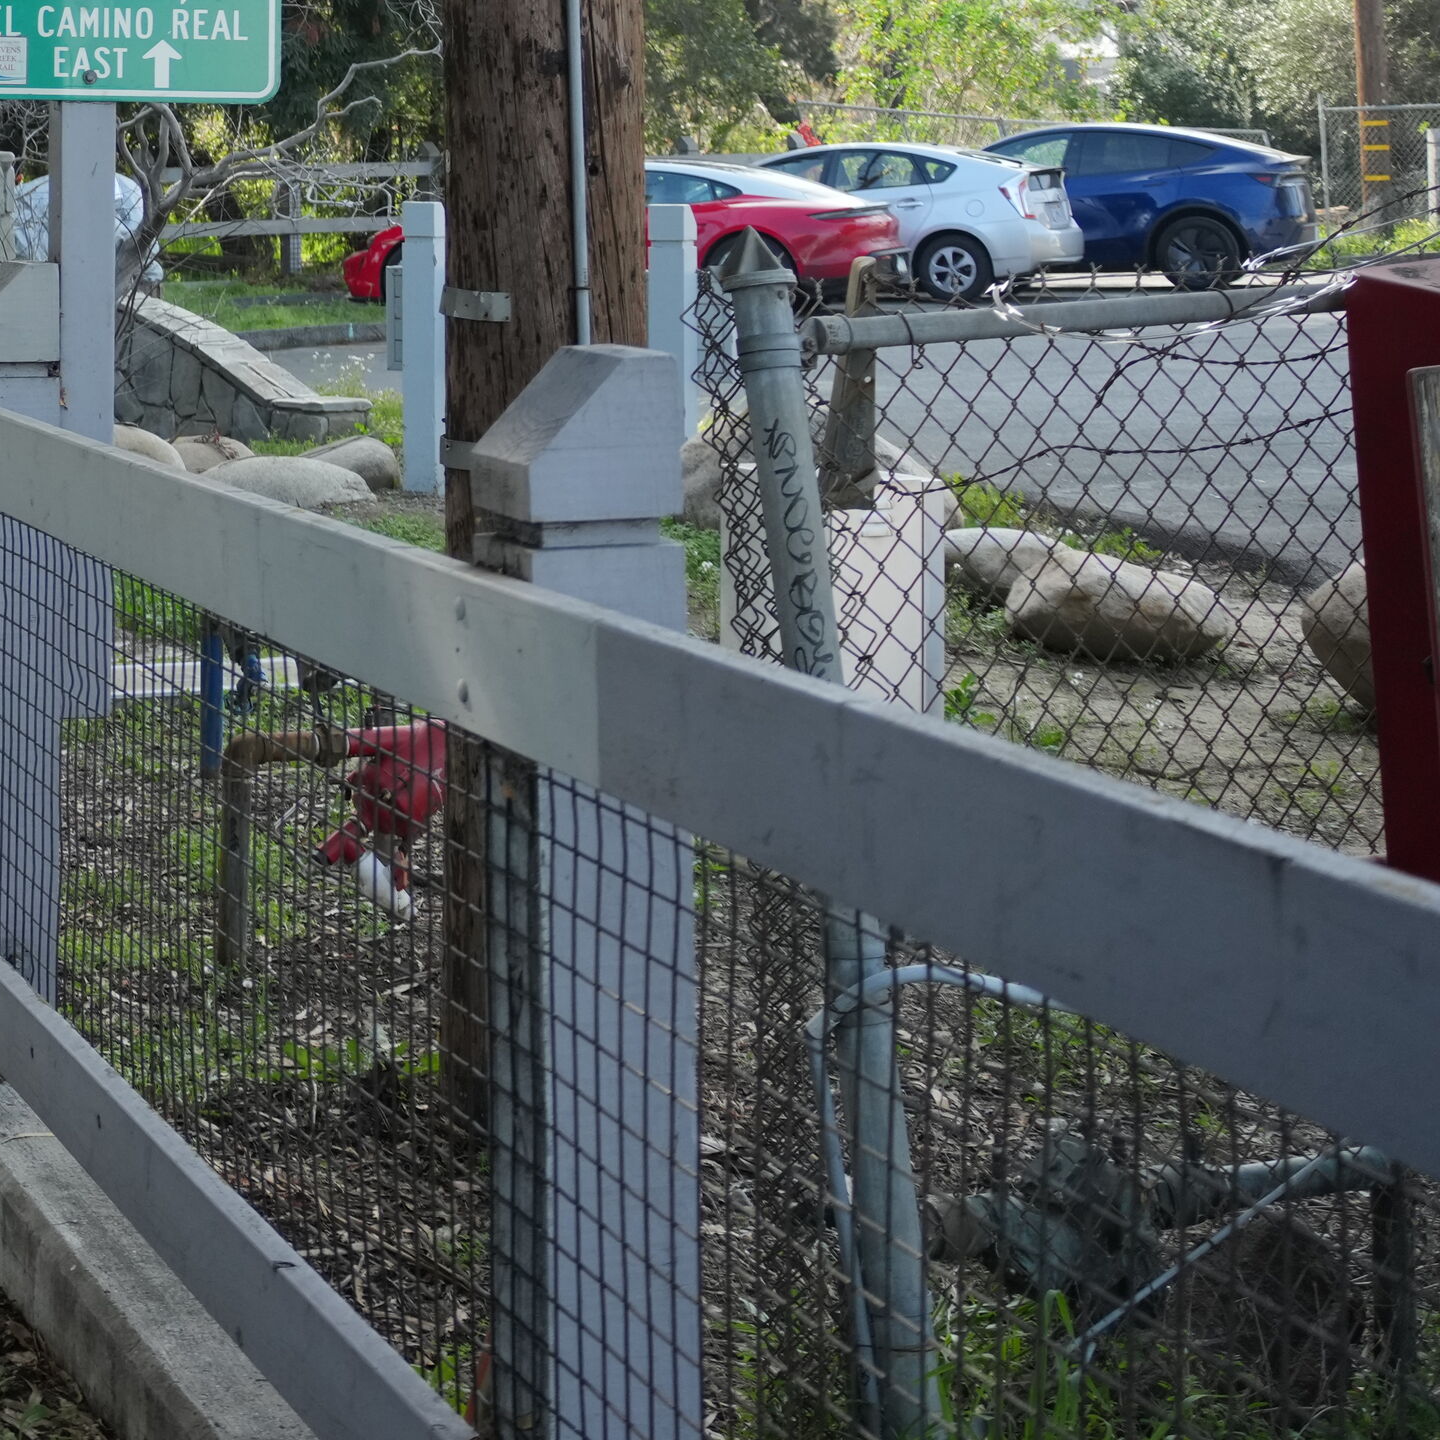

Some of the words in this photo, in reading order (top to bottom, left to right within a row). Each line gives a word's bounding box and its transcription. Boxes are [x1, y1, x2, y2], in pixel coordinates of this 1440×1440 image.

[37, 6, 154, 39] CAMINO
[171, 9, 248, 41] REAL
[53, 47, 128, 79] EAST
